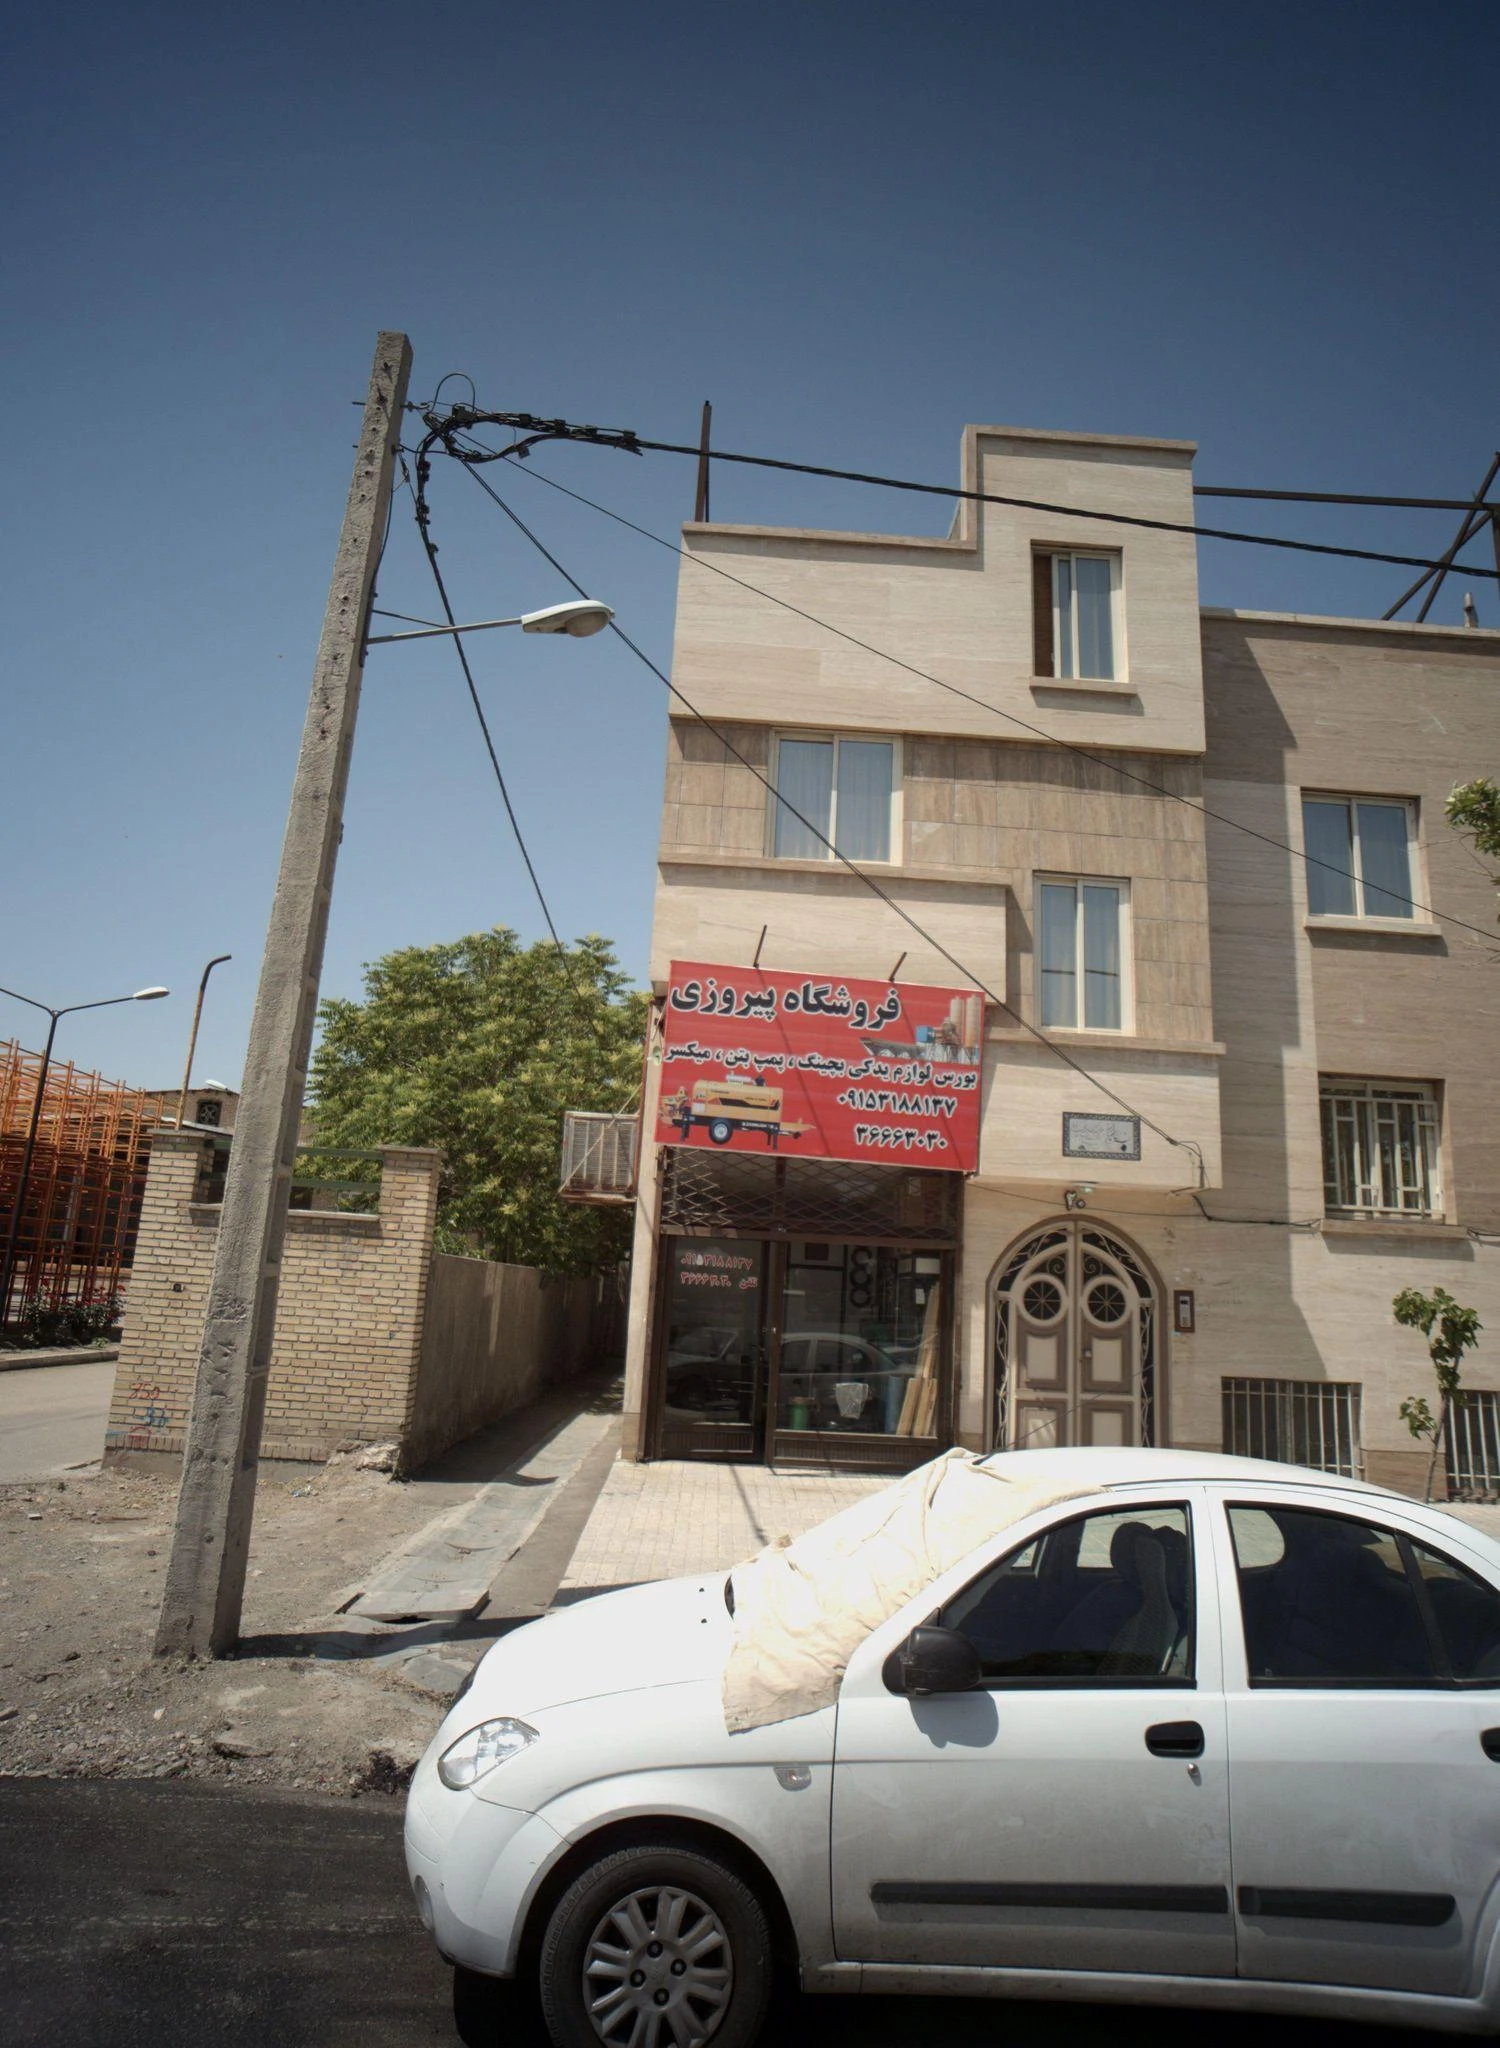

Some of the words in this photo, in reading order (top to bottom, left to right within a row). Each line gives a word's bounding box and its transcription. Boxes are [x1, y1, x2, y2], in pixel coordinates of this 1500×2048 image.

[671, 978, 776, 1021] پیروزی
[784, 982, 900, 1030] فروشگاه
[664, 1041, 711, 1064] میکسر
[724, 1049, 750, 1067] بتن
[753, 1052, 785, 1071] پمپ
[798, 1053, 844, 1078] بچینگ
[848, 1057, 889, 1081] یدکی
[893, 1062, 932, 1085] لوازم
[935, 1072, 977, 1088] بورس
[837, 1088, 957, 1118] ۰۹۱۵۳۱۸۸۱۳۷
[855, 1124, 947, 1151] ۳۶۶۶۳۰۳۰
